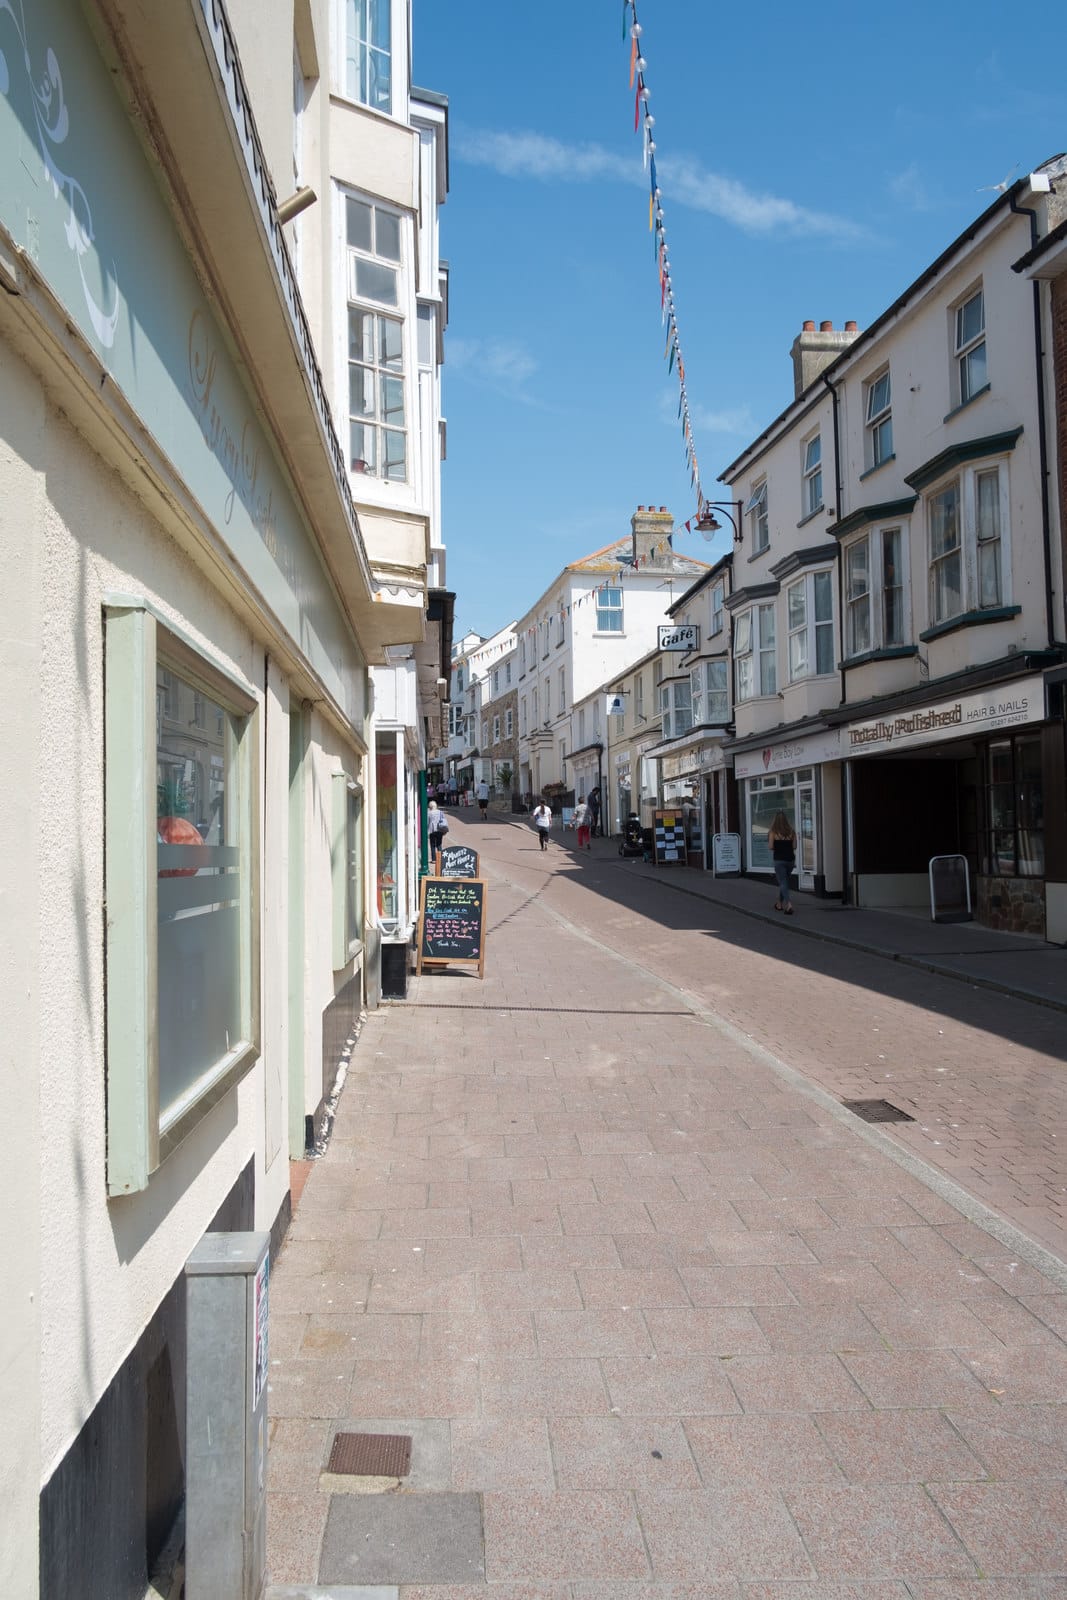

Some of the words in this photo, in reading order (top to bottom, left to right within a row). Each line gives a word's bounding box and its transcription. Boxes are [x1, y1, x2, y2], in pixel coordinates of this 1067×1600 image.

[661, 628, 693, 648] Café
[848, 720, 894, 743] Totally
[894, 704, 962, 735] Polished
[967, 707, 988, 721] HAIR
[989, 705, 996, 716] &
[998, 699, 1029, 714] NAILS
